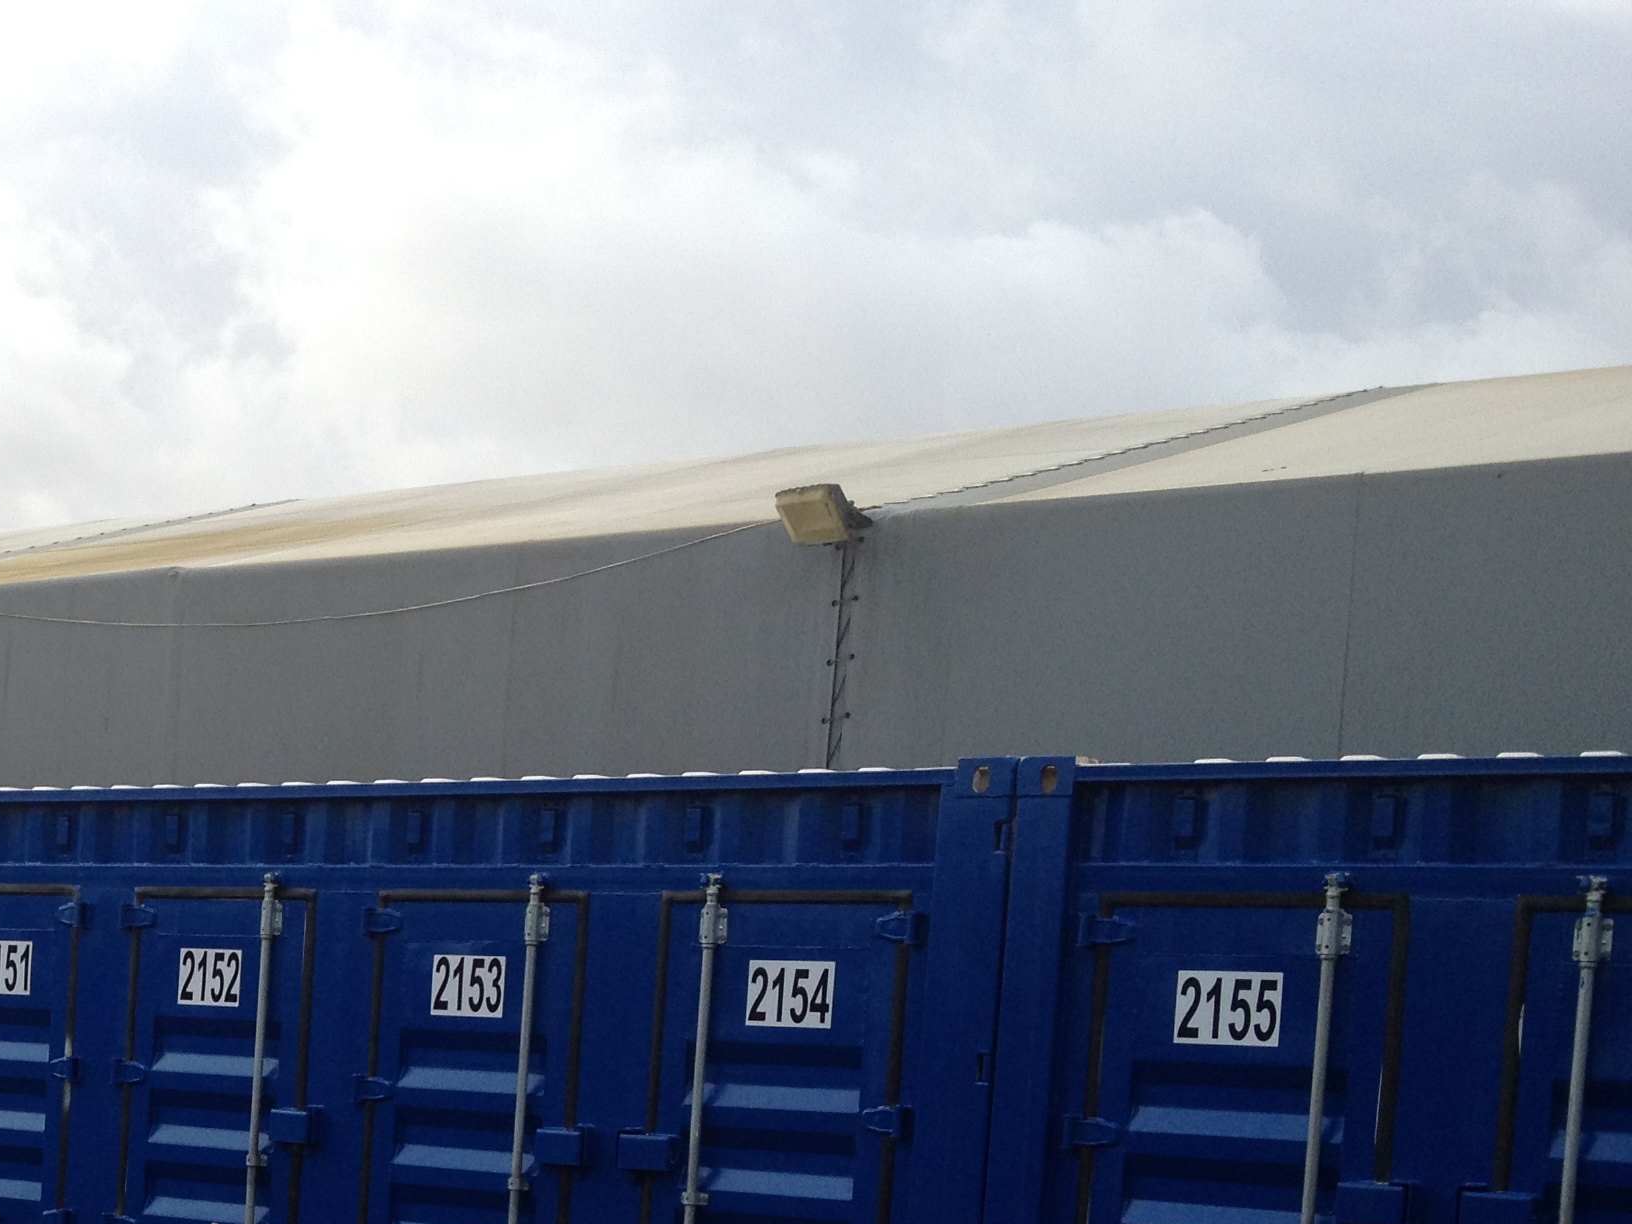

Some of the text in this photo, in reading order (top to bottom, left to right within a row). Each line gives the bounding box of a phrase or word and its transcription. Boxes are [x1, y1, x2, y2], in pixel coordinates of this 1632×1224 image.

[180, 951, 240, 1004] 2152
[434, 957, 502, 1013] 2153
[748, 966, 830, 1024] 2154
[1179, 977, 1279, 1042] 2155
